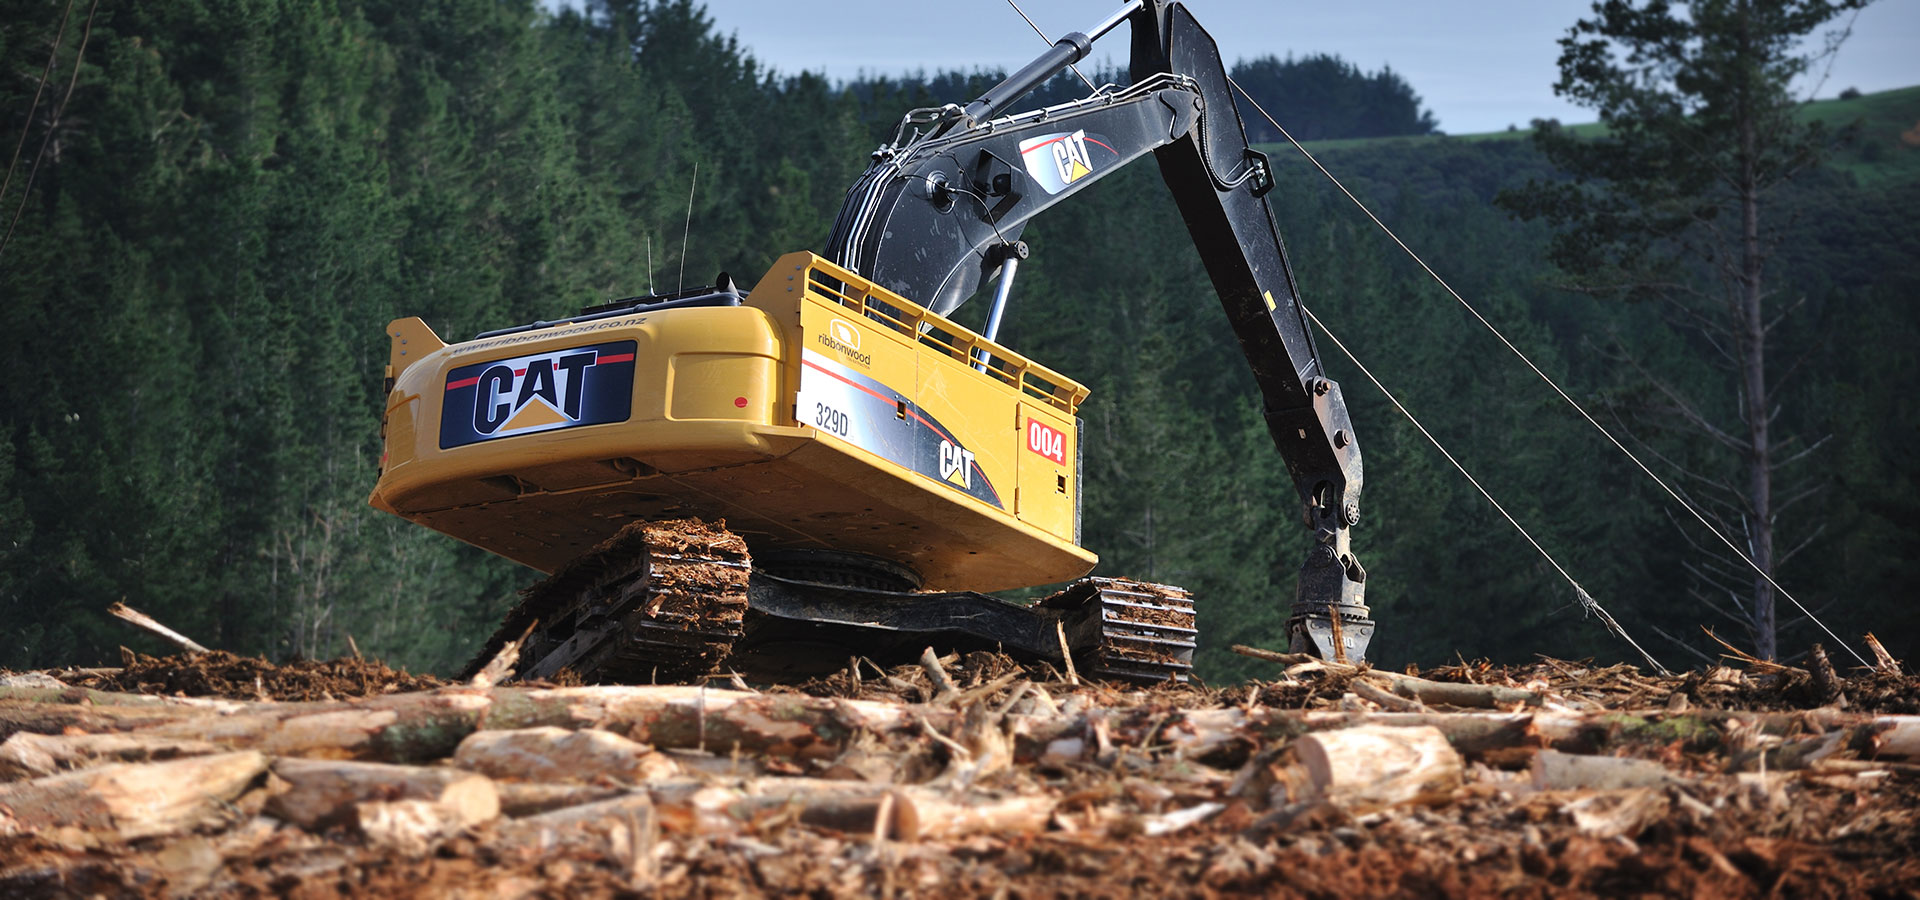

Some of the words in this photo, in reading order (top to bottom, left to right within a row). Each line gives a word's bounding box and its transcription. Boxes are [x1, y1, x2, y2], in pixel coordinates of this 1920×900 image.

[1052, 128, 1093, 185] CAT
[453, 316, 648, 354] www.ribbonwood.co.nz
[818, 333, 871, 366] ribbonwood
[474, 321, 598, 435] CAT
[816, 402, 848, 437] 329D
[1031, 422, 1064, 463] 004
[939, 440, 975, 490] CAT
